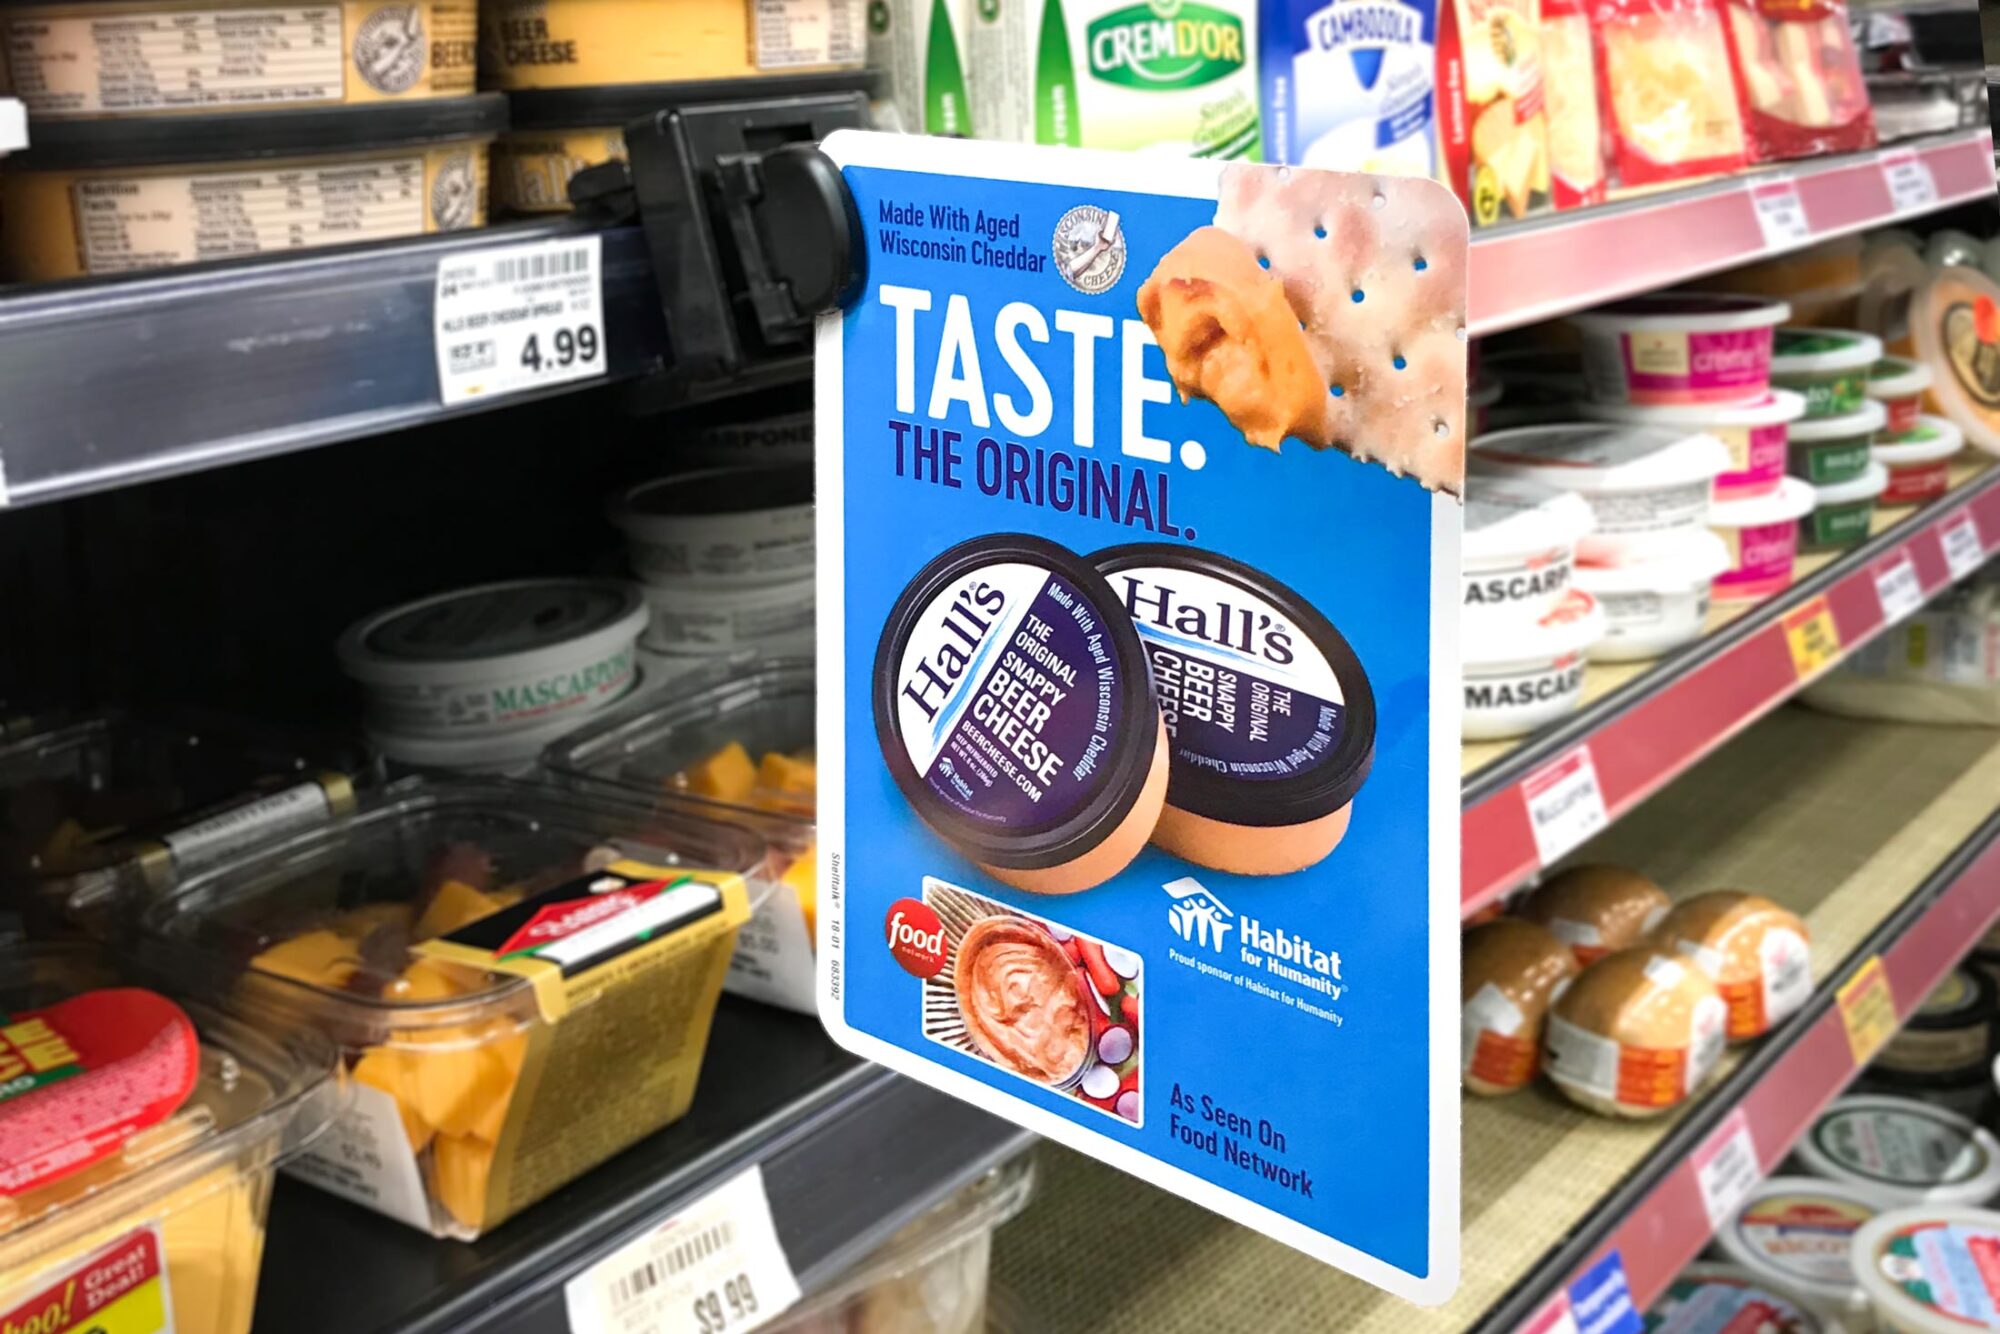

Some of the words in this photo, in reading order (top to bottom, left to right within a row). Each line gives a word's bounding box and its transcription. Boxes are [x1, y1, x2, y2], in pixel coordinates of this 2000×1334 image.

[879, 198, 924, 227] Made
[929, 204, 969, 232] With
[975, 209, 1020, 242] Aged
[880, 229, 966, 263] Wisconsin
[971, 240, 1047, 273] Cheddar
[521, 324, 598, 372] 4.99
[879, 284, 1207, 471] TASTE.
[889, 420, 962, 489] THE
[976, 436, 1197, 541] ORIGINAL.
[1047, 582, 1074, 610] Made
[1071, 603, 1095, 634] With
[1123, 576, 1294, 665] Hall's
[902, 582, 1005, 723] Hall's
[1025, 614, 1054, 643] THE
[1087, 633, 1110, 665] Aged
[1003, 651, 1067, 706] SNAPPY
[1016, 632, 1080, 688] ORIGINAL
[986, 668, 1052, 733] BEER
[1094, 665, 1115, 733] Wisconsin
[1182, 660, 1214, 722] BEER
[1215, 670, 1238, 734] SNAPPY
[1249, 681, 1270, 743] ORIGINAL
[1272, 689, 1292, 717] THE
[973, 694, 1064, 786] CHEESE
[1305, 731, 1332, 753] With
[1319, 705, 1337, 732] Made
[961, 720, 1043, 803] BEERCHEESE.COM
[1072, 734, 1108, 782] Cheddar
[1230, 754, 1292, 776] Wisconsin
[1292, 747, 1315, 769] Aged
[889, 911, 945, 956] food
[1240, 915, 1342, 980] Habitat
[830, 959, 840, 1001] 683392
[1169, 948, 1195, 968] Proud
[1197, 960, 1232, 982] sponsor
[1234, 975, 1244, 986] of
[1245, 977, 1280, 1001] Habitat
[1281, 991, 1295, 1007] for
[1296, 997, 1343, 1028] Humanity
[1240, 947, 1262, 967] for
[1267, 956, 1342, 1001] Humanity
[1170, 1082, 1195, 1114] As
[1201, 1094, 1251, 1139] Seen
[1259, 1119, 1286, 1153] On
[1170, 1113, 1217, 1157] Food
[1224, 1136, 1313, 1199] Network
[84, 1243, 146, 1291] Great
